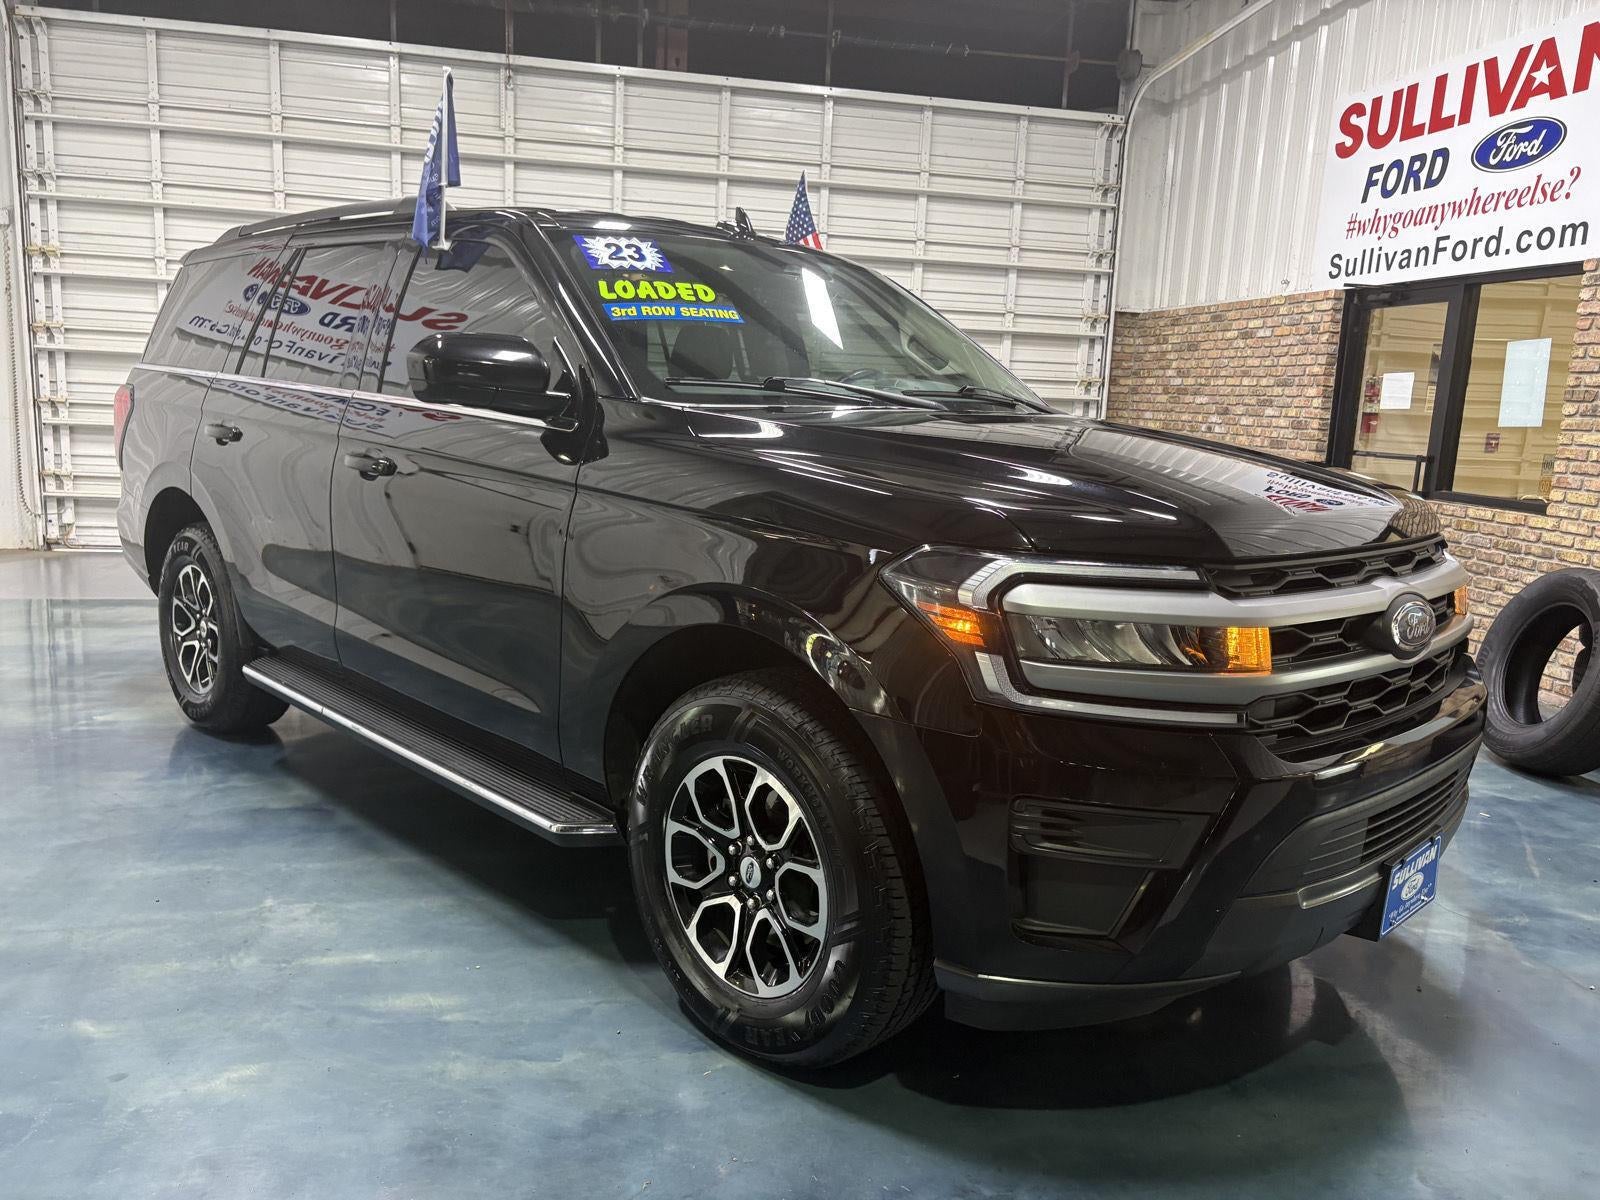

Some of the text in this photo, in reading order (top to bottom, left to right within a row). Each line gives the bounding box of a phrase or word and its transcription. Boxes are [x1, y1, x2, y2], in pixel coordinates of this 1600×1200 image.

[1489, 125, 1547, 165] Ford
[1360, 147, 1450, 204] FORD
[1345, 166, 1581, 241] #whygoanywhereelse?
[604, 242, 647, 262] 23
[1328, 220, 1589, 280] SullivanFord.com
[598, 279, 716, 303] LOADED
[611, 306, 739, 320] 3rd ROW SEATING
[1406, 612, 1431, 639] Ford
[1391, 844, 1438, 891] SULLIVAN
